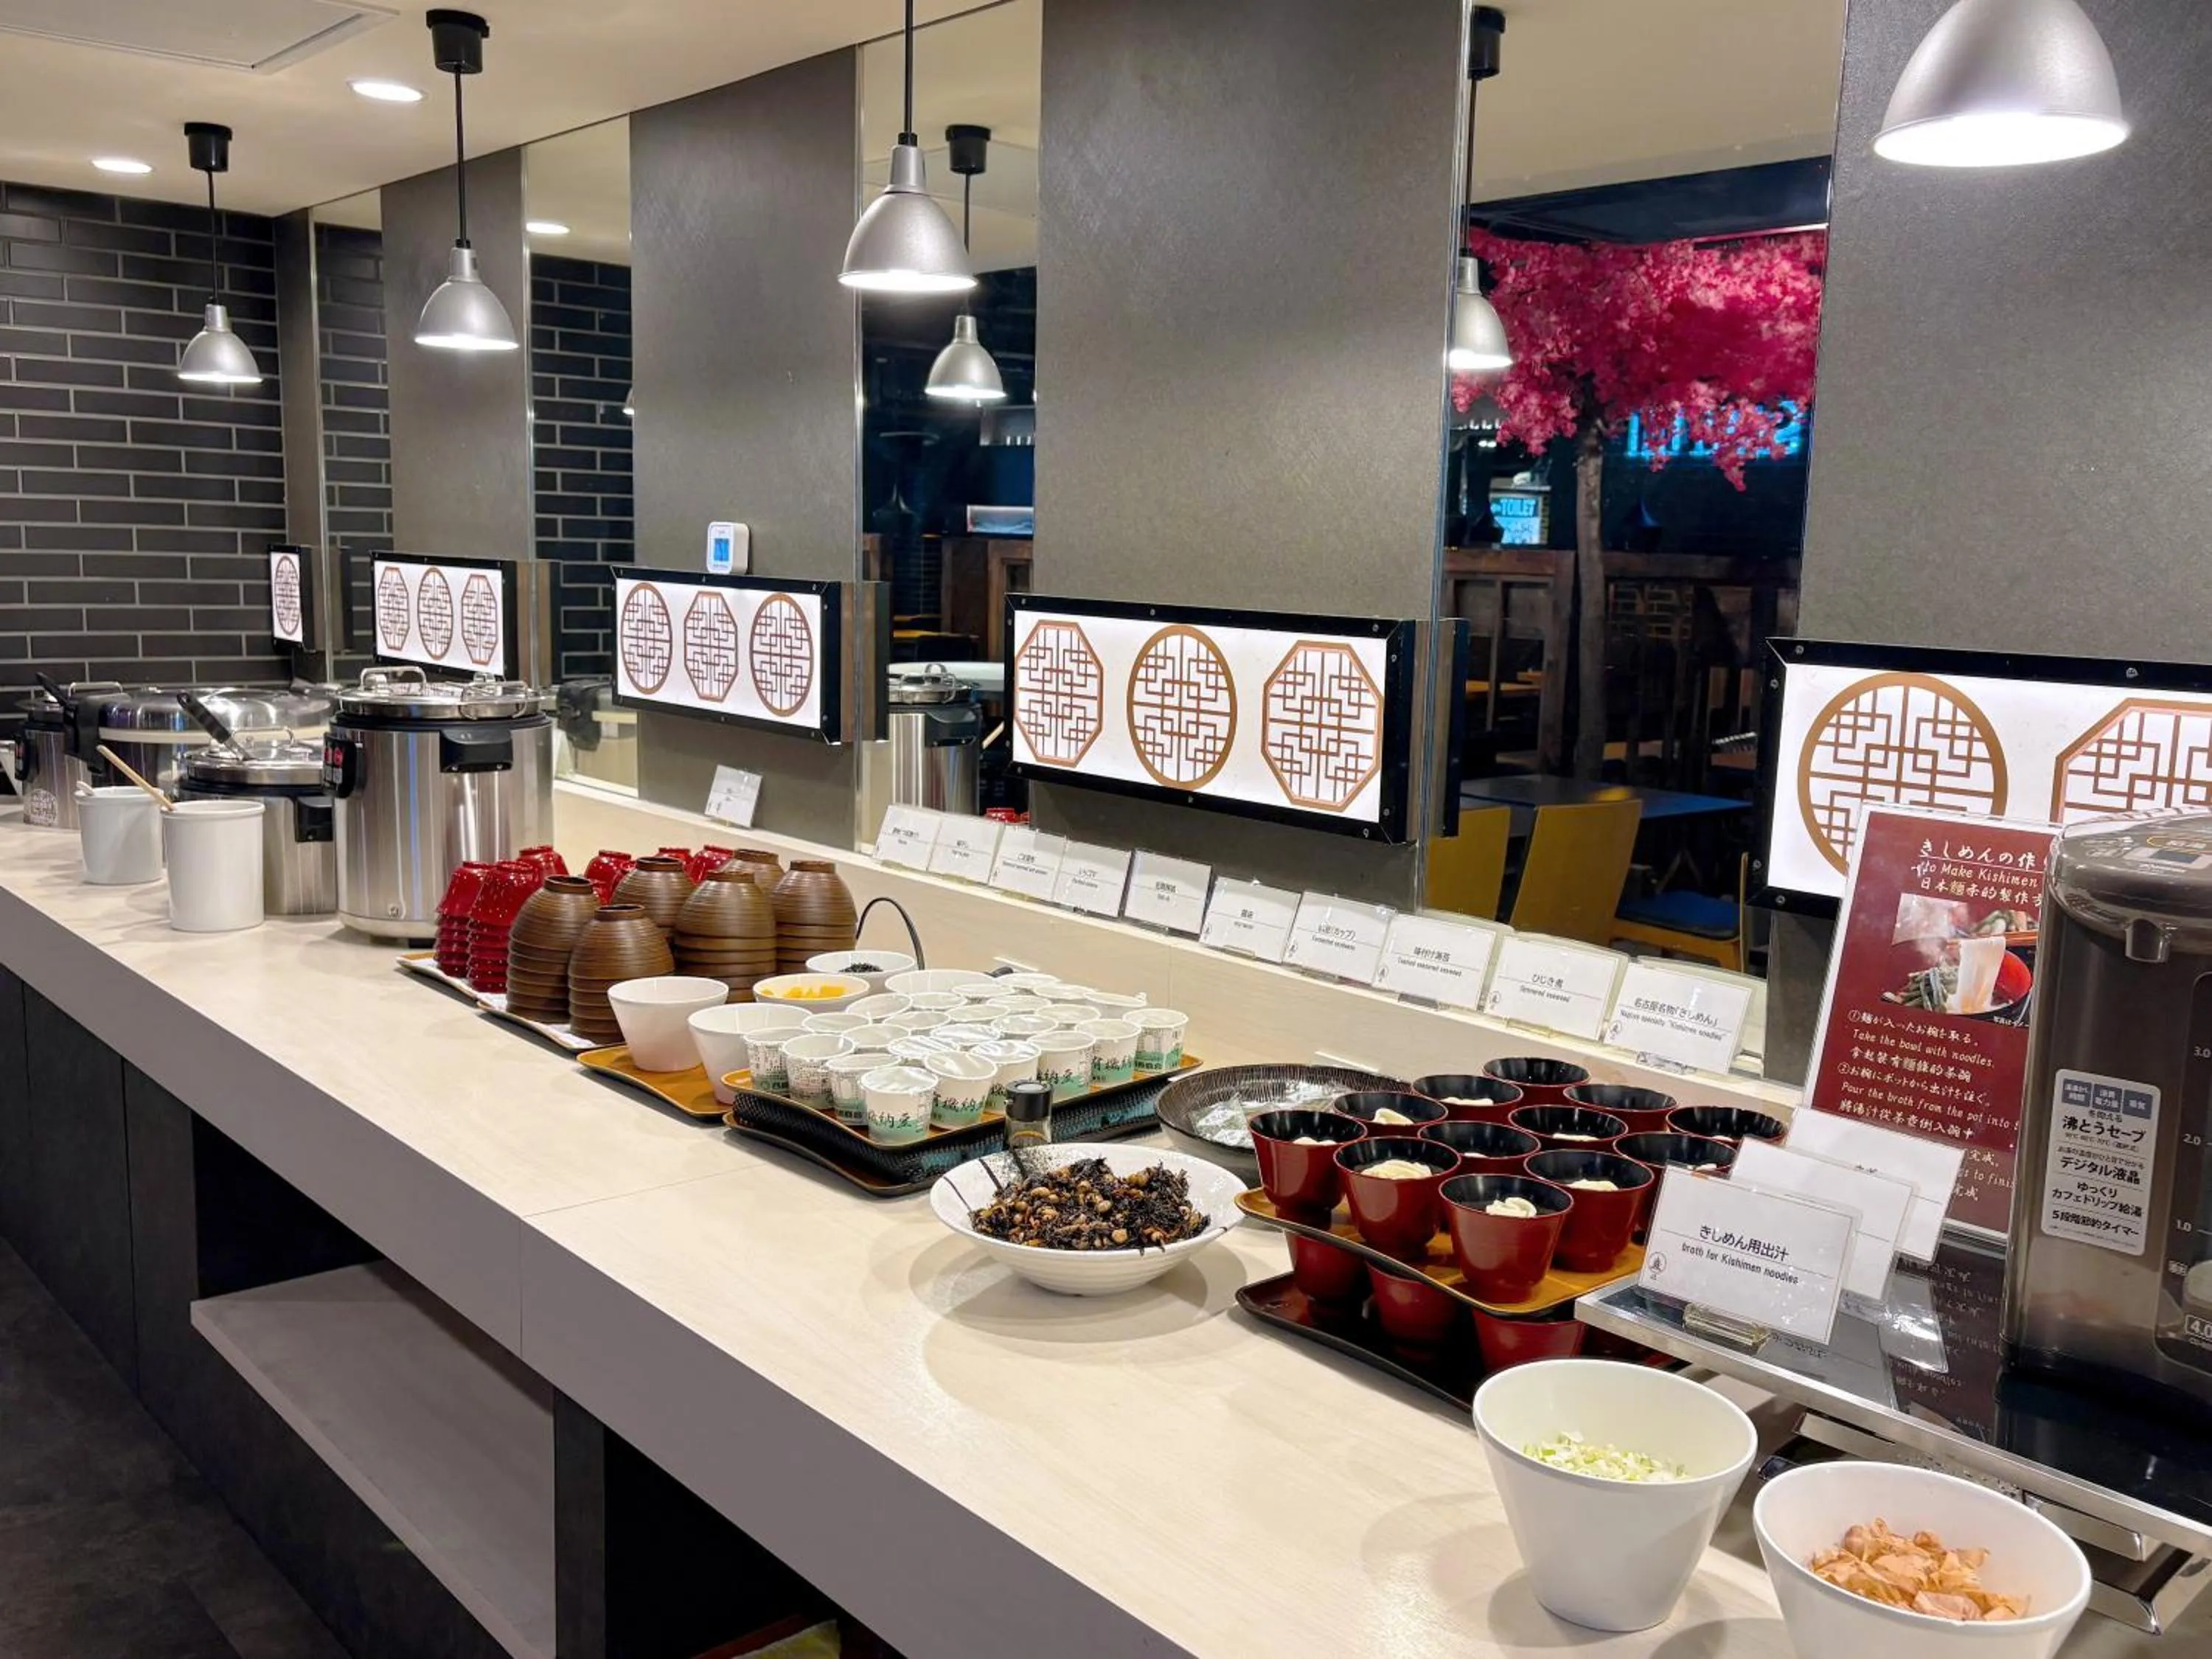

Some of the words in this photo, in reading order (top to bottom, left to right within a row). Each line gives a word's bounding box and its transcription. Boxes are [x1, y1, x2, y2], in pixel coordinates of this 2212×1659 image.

[1919, 838, 2048, 870] きしめんの作
[1941, 863, 1973, 878] Make
[1978, 868, 2038, 887] Kishimen
[1853, 1029, 1877, 1043] Take
[1879, 1034, 1896, 1047] the
[1899, 1038, 1922, 1052] bowl
[1925, 1045, 1947, 1058] with
[2194, 1046, 2211, 1058] 3.0
[1841, 1081, 1864, 1094] Pour
[1868, 1088, 1884, 1099] the
[1888, 1091, 1913, 1107] broth
[1917, 1098, 1942, 1113] from
[1947, 1105, 1964, 1118] the
[1966, 1113, 1983, 1122] pot
[1987, 1114, 2010, 1129] into
[2062, 1115, 2146, 1142] 沸とうセーブ
[2183, 1133, 2202, 1146] 2.0
[1974, 1169, 1984, 1180] to
[2061, 1156, 2140, 1185] デジタル液晶
[2052, 1188, 2143, 1217] カフェドリップ給湯
[2077, 1182, 2118, 1198] ゆっくり
[2177, 1219, 2192, 1232] 1.0
[1700, 1224, 1789, 1262] きしめん用出汁
[1682, 1242, 1703, 1257] broth
[1706, 1249, 1718, 1261] for
[1721, 1253, 1761, 1273] Kishimen
[1764, 1264, 1799, 1285] noodles
